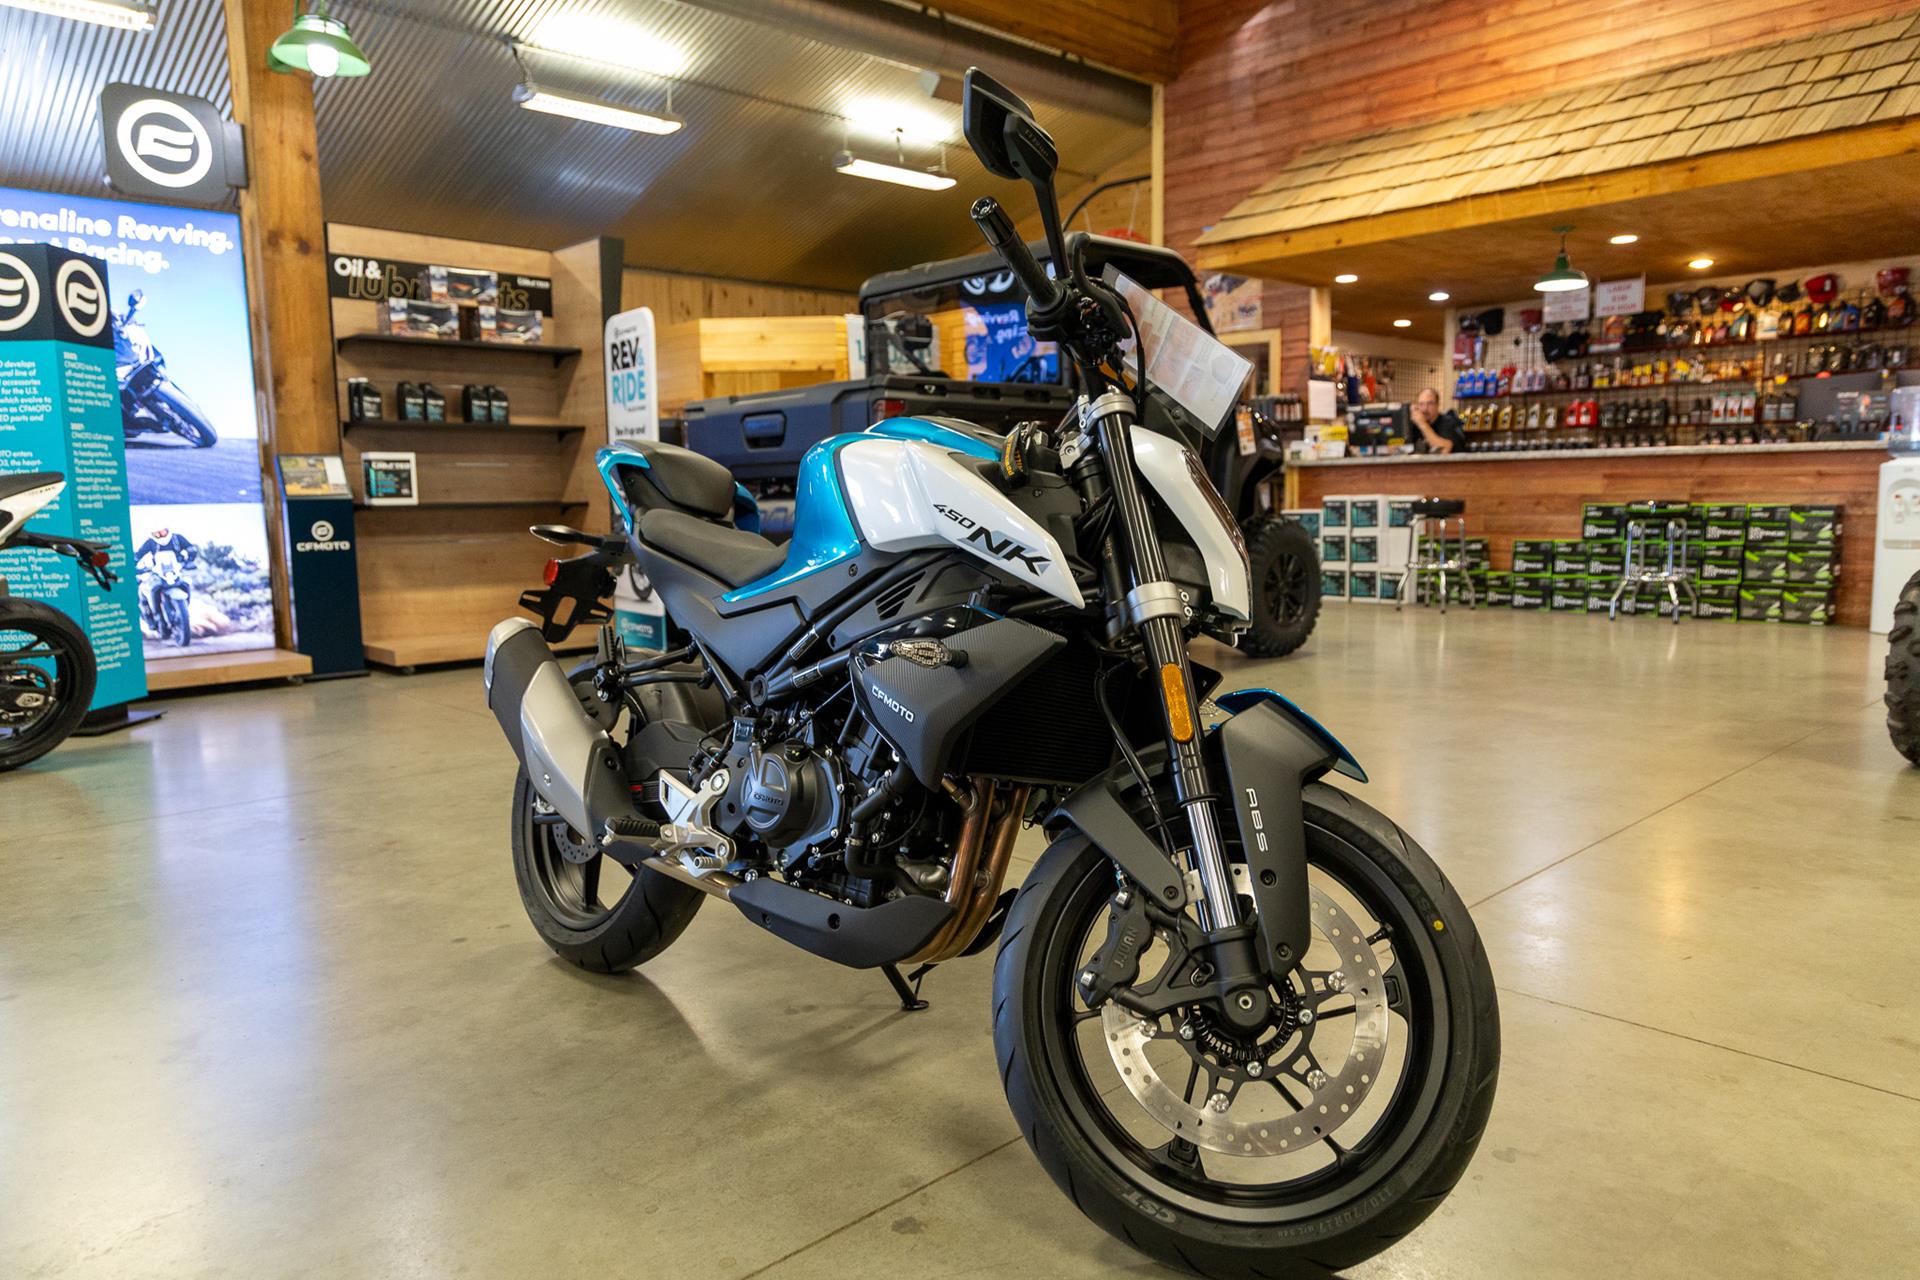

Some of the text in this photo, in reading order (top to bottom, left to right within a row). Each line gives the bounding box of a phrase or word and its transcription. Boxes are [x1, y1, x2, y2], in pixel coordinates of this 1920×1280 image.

[117, 215, 234, 255] Revving.
[333, 257, 381, 280] Oil &
[611, 337, 639, 371] REV
[611, 370, 646, 406] RIDE
[296, 541, 351, 552] CFMOTO
[933, 503, 1052, 577] 450 NK
[871, 683, 915, 723] CFMOTO
[1245, 788, 1269, 852] ABS
[1121, 1190, 1177, 1223] CST
